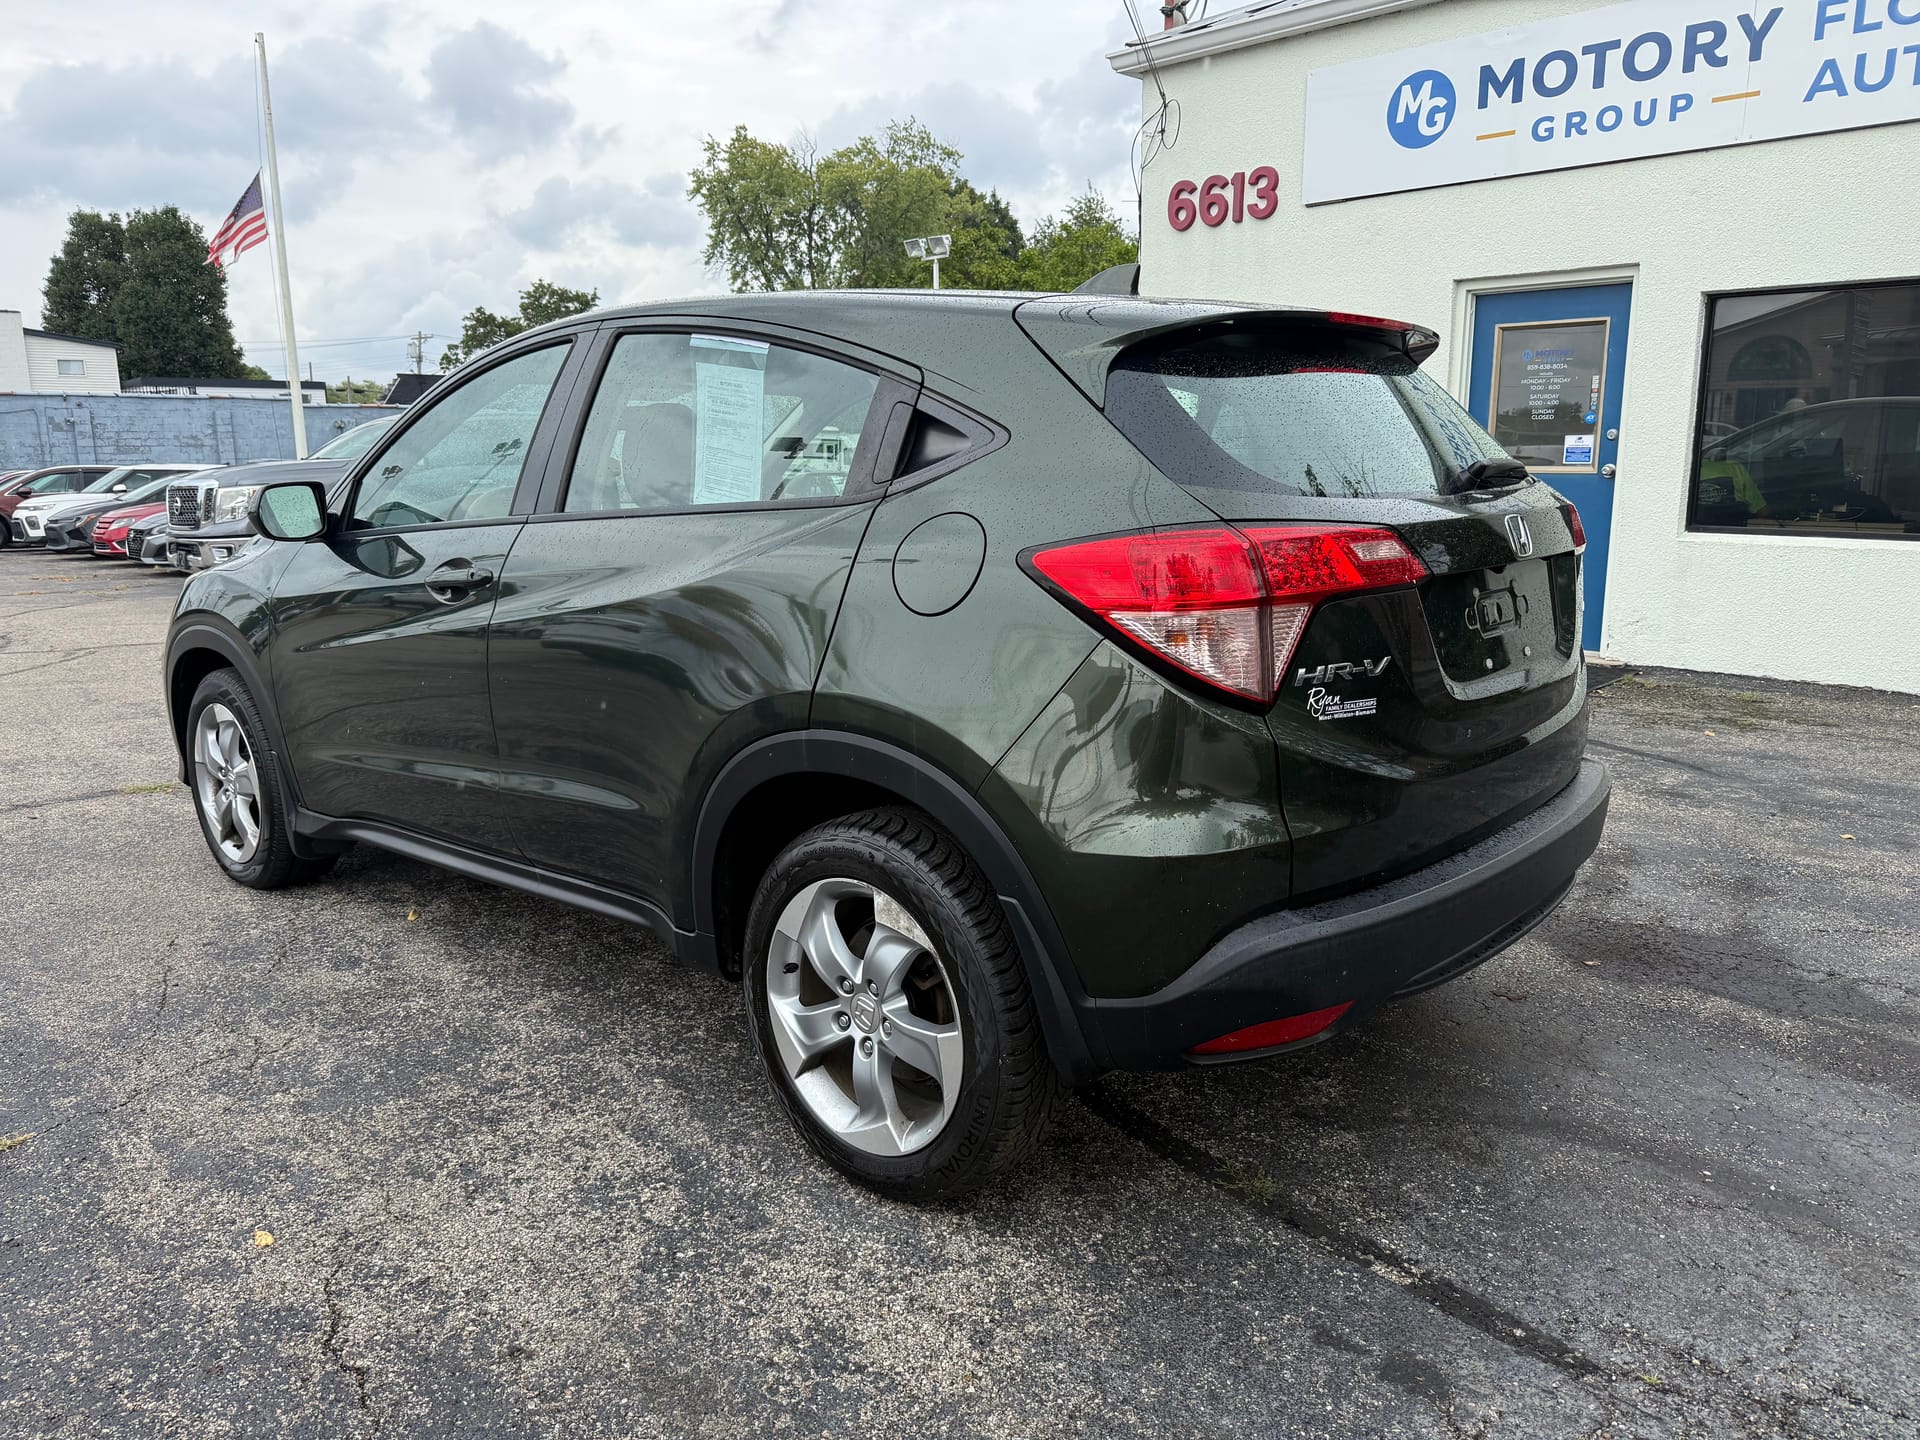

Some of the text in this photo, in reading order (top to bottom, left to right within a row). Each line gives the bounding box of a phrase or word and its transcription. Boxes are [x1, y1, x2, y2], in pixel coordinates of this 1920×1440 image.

[1477, 7, 1784, 110] MOTORY
[1531, 93, 1694, 142] GROUP
[1168, 166, 1279, 232] 6613
[1295, 656, 1391, 686] HR-V
[1307, 687, 1341, 717] Ryan
[1344, 700, 1377, 709] DEALERSHIPS
